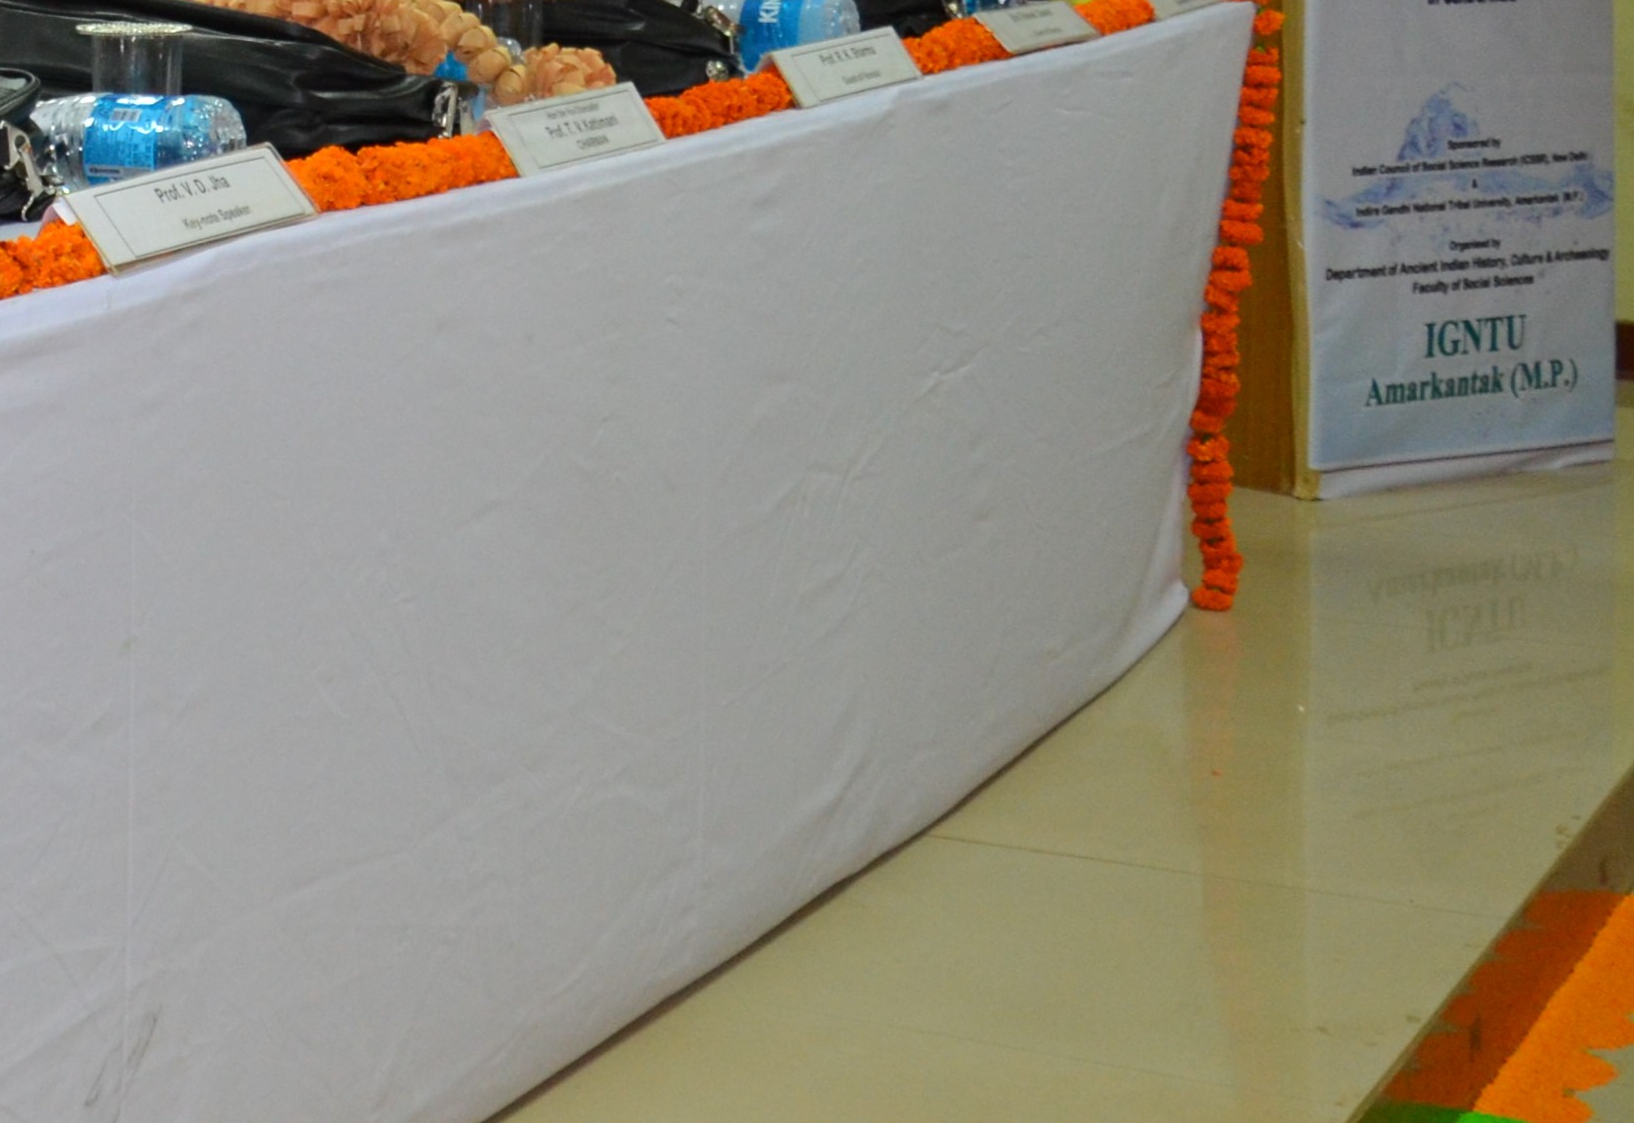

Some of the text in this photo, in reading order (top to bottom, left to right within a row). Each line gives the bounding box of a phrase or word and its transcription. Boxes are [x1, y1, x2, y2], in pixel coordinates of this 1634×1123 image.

[153, 175, 231, 205] Prof. V. D. Jha
[1424, 313, 1528, 359] IGNTU
[1364, 358, 1579, 408] Amarkantak (M.P.)
